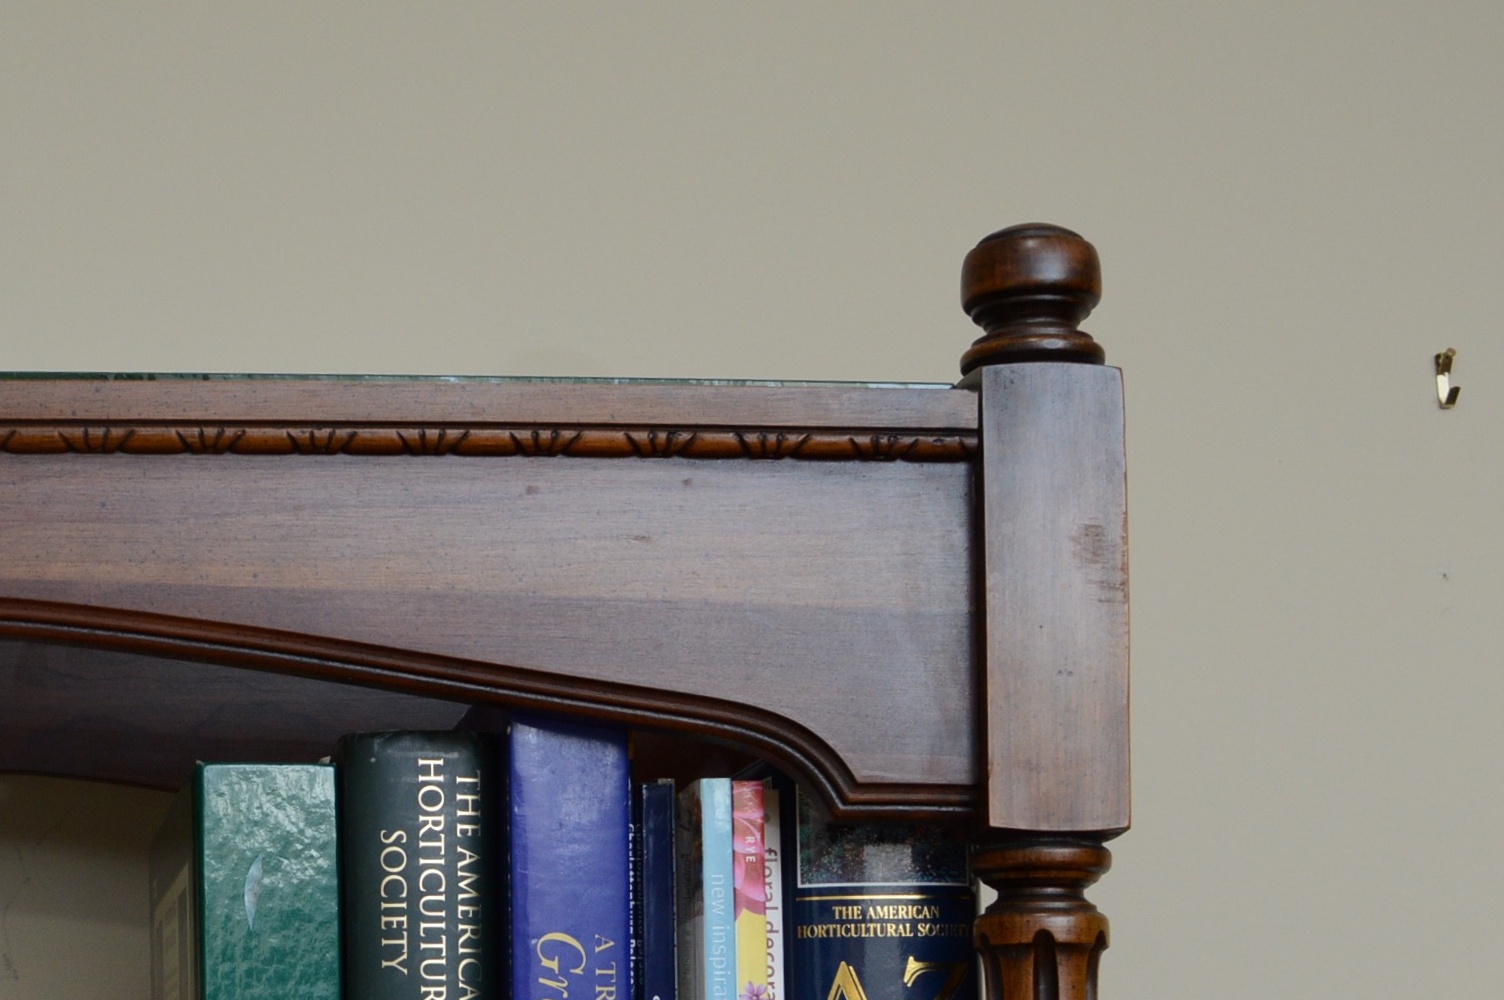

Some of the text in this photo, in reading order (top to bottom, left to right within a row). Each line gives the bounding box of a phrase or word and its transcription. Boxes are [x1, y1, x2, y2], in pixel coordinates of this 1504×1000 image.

[456, 770, 481, 837] THE
[744, 836, 756, 863] RYE
[710, 873, 725, 915] new
[763, 847, 779, 911] floral
[380, 830, 408, 975] SOCIETY
[832, 905, 939, 919] THE AMERICAN
[595, 933, 615, 953] A
[798, 923, 914, 938] HORTICULTURAL
